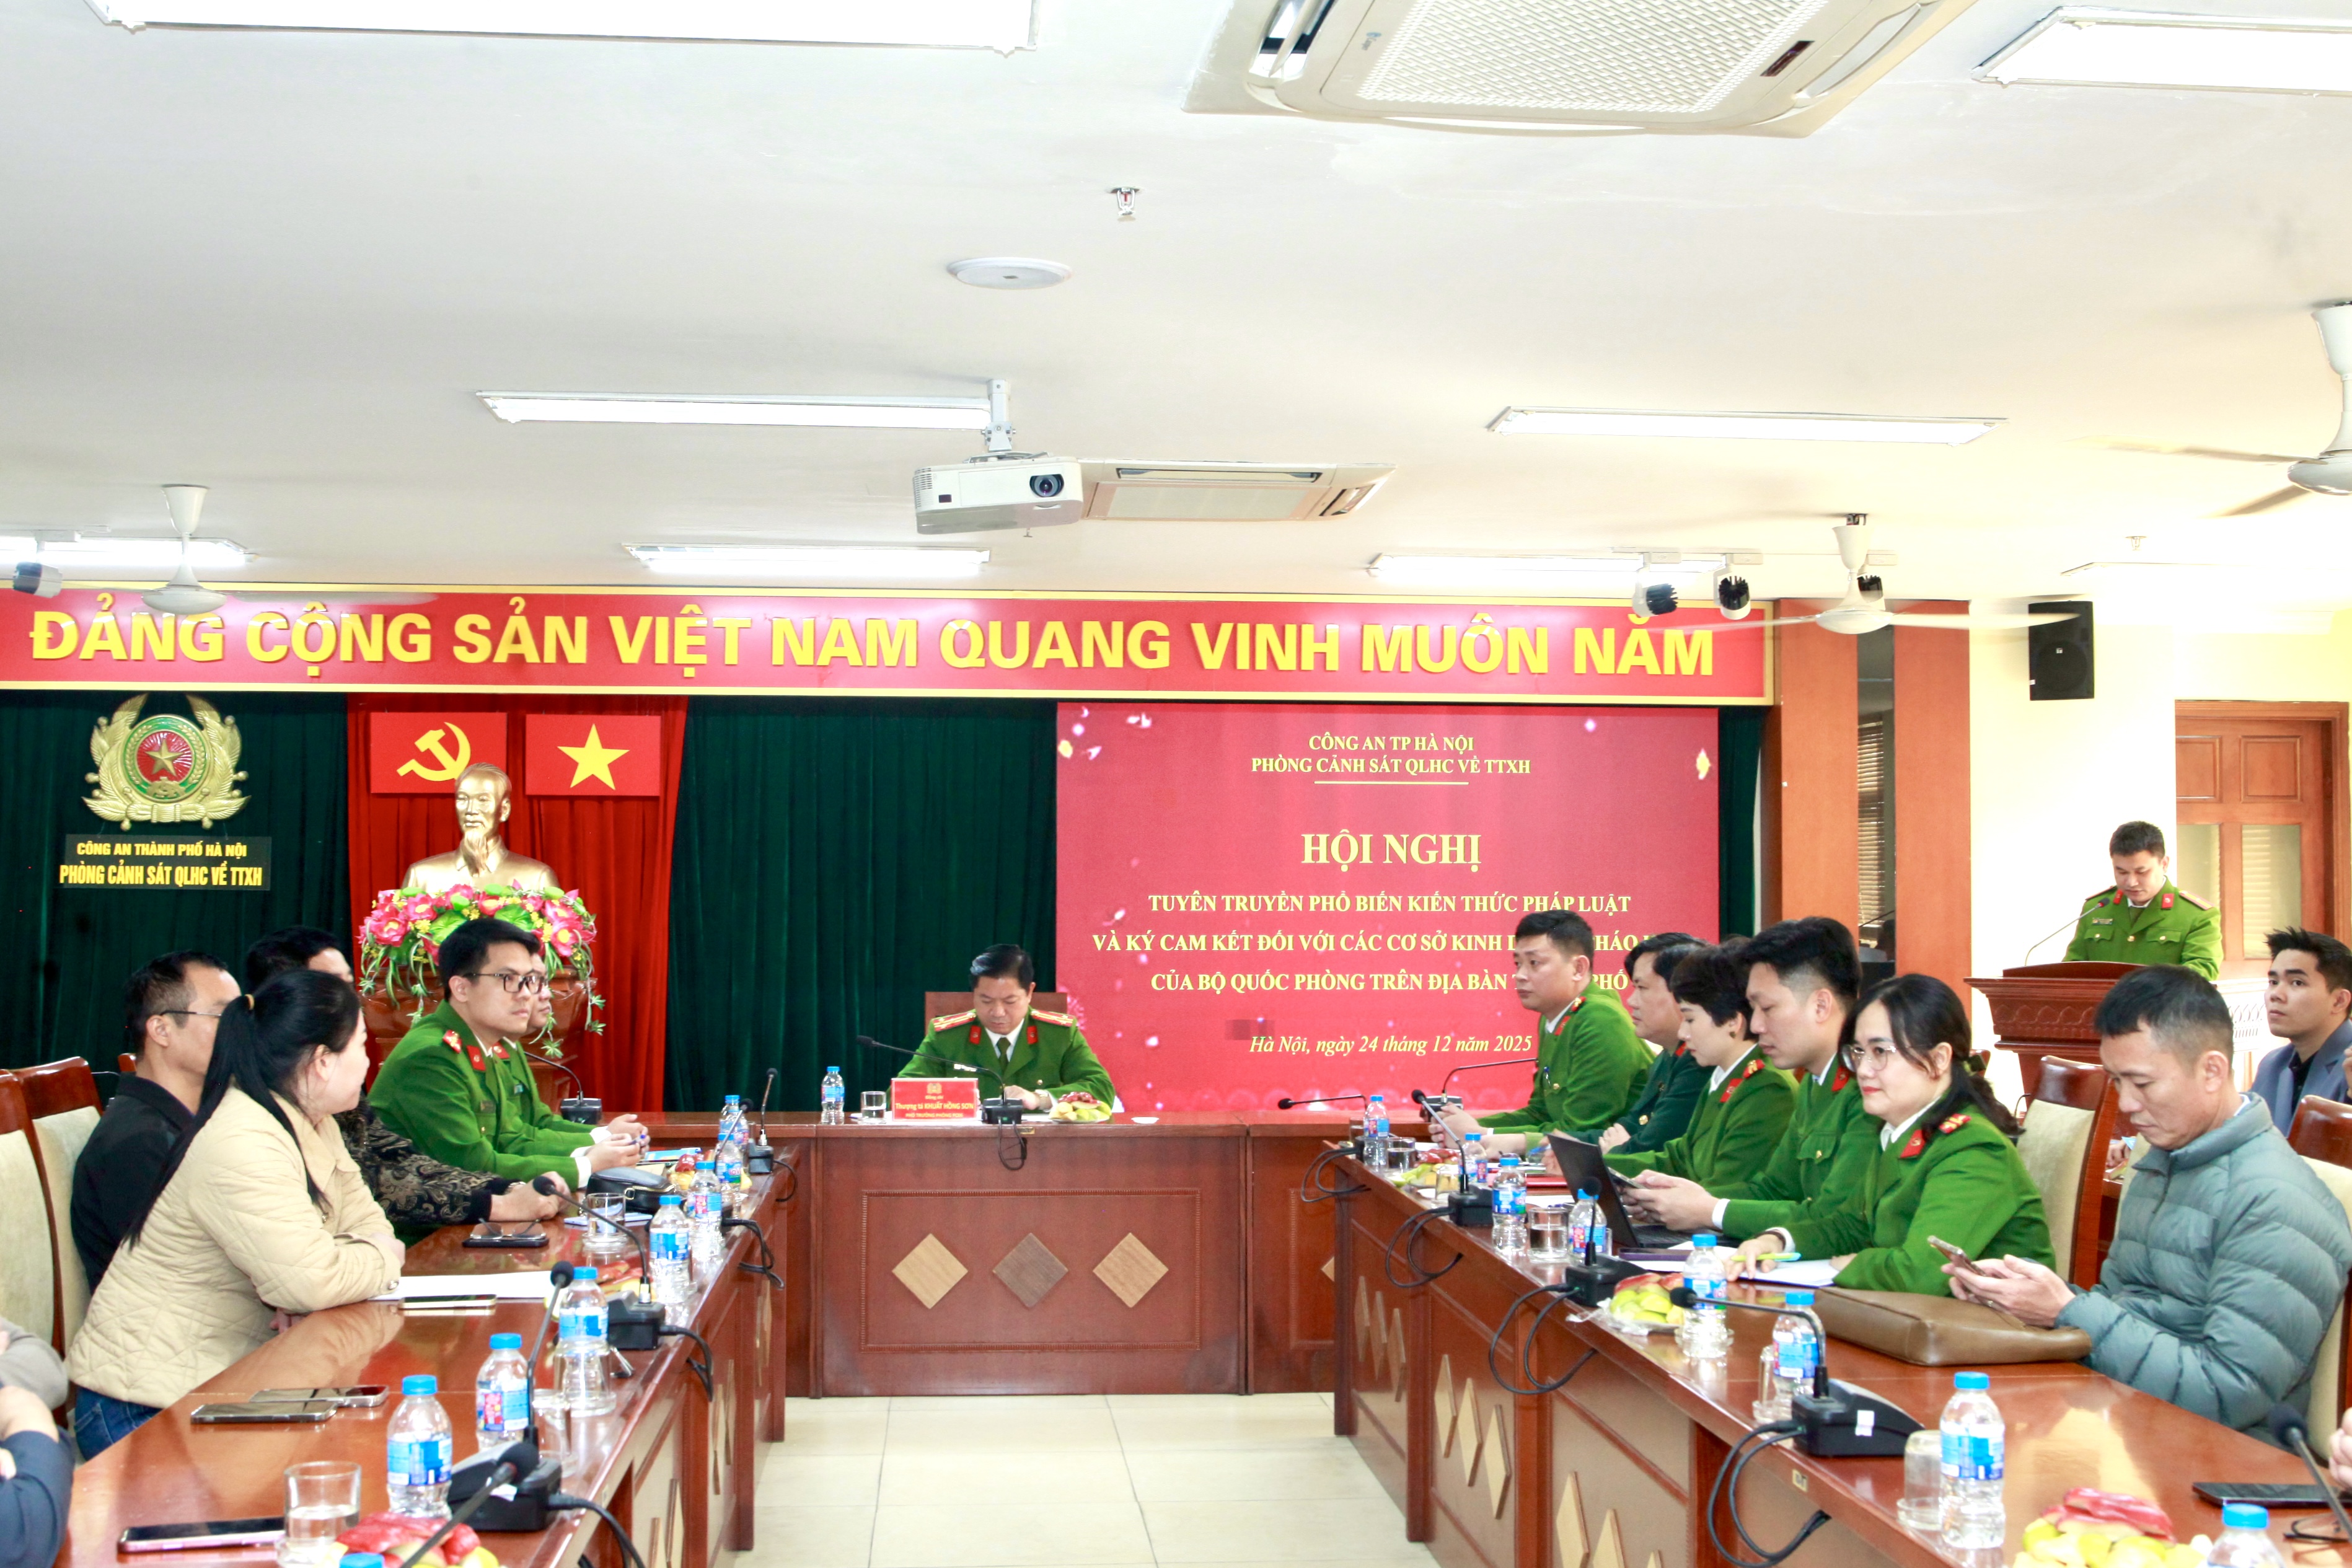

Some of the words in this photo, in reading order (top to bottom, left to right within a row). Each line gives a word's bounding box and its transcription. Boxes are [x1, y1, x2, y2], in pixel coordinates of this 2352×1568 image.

[30, 592, 224, 662] ĐẢNG
[246, 602, 432, 677] CỘNG
[453, 596, 588, 664] SẢN
[609, 604, 751, 677] VIỆT
[772, 617, 917, 667] NAM
[939, 619, 1171, 669] QUANG
[1191, 622, 1339, 672] VINH
[1362, 612, 1549, 674] MUÔN
[1574, 614, 1713, 676] NĂM
[1308, 731, 1359, 751] CÔNG
[1362, 736, 1386, 751] AN
[1390, 736, 1412, 751] TP
[1414, 733, 1440, 751] HÀ
[1443, 735, 1474, 755] NỘI
[1251, 754, 1313, 773] PHÒNG
[1316, 755, 1365, 773] CẢNH
[1368, 755, 1402, 773] SÁT
[1405, 759, 1454, 777] QLHC
[1457, 755, 1481, 773] VỀ
[1484, 759, 1531, 774] TTXH
[76, 840, 111, 855] CÔNG
[113, 843, 132, 856] AN
[134, 841, 175, 857] THÀNH
[178, 840, 203, 857] PHỐ
[205, 842, 222, 857] HÀ
[225, 842, 247, 860] NỘI
[1301, 829, 1373, 873] HỘI
[1383, 833, 1482, 873] NGHỊ
[59, 860, 105, 884] PHÒNG
[107, 859, 144, 885] CẢNH
[146, 862, 172, 885] SÁT
[174, 866, 209, 888] QLHC
[211, 861, 227, 886] VỀ
[230, 867, 263, 886] TTXH
[1148, 890, 1217, 912] TUYÊN
[1221, 890, 1304, 912] TRUYỀN
[1308, 890, 1351, 912] PHỔ
[1355, 891, 1402, 912] BIẾN
[1407, 891, 1456, 912] KIẾN
[1461, 892, 1518, 912] THỨC
[1523, 891, 1575, 912] PHÁP
[1578, 894, 1631, 917] LUẬT
[1093, 930, 1121, 951] VÀ
[1125, 930, 1155, 951] KÝ
[1160, 935, 1207, 951] CAM
[1212, 930, 1253, 951] KẾT
[1257, 930, 1294, 951] ĐỐI
[1299, 930, 1336, 951] VỚI
[1339, 930, 1382, 951] CÁC
[1386, 935, 1417, 951] CƠ
[1420, 930, 1449, 951] SỞ
[1451, 935, 1502, 951] KINH
[1592, 930, 1639, 951] HÁO
[1151, 969, 1194, 990] CỦA
[1197, 972, 1226, 995] BỘ
[1230, 969, 1289, 993] QUỐC
[1293, 969, 1365, 990] PHÒNG
[1369, 969, 1423, 990] TRÊN
[1428, 974, 1463, 994] ĐỊA
[1468, 969, 1507, 990] BÀN
[1249, 1036, 1275, 1052] Hà
[1278, 1036, 1310, 1055] Nội,
[1316, 1036, 1354, 1057] ngày
[1359, 1036, 1378, 1052] 24
[1383, 1036, 1428, 1056] tháng
[1433, 1036, 1450, 1052] 12
[1455, 1036, 1489, 1052] năm
[1494, 1035, 1533, 1052] 2025
[896, 1103, 917, 1111] Thượng
[924, 1101, 943, 1109] KHUẤT
[944, 1101, 961, 1109] HỒNG
